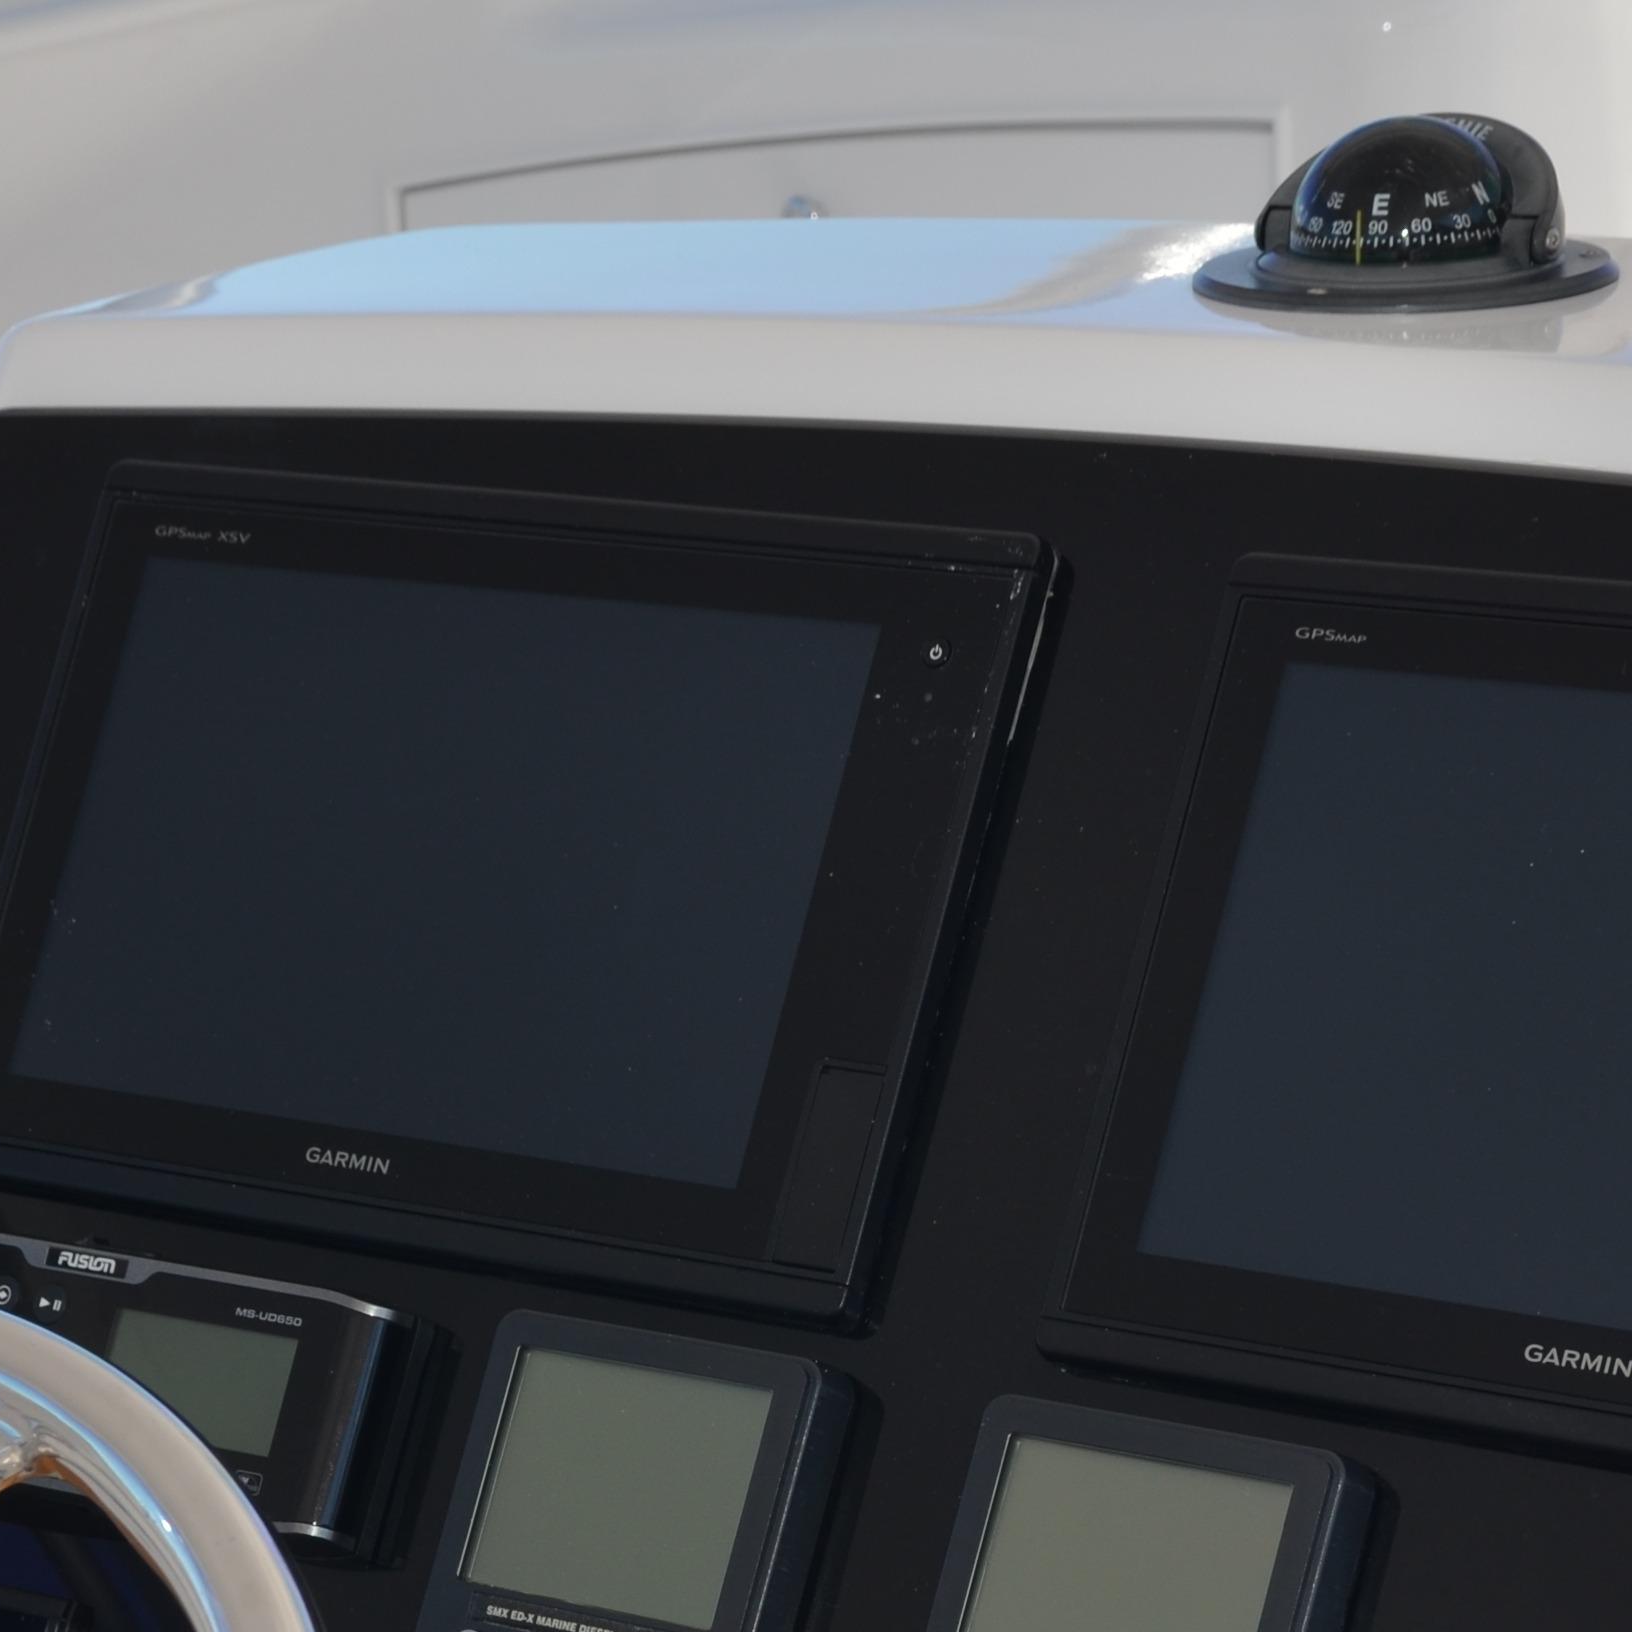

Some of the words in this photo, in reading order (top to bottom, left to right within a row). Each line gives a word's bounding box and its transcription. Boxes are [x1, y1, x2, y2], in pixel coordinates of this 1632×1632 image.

[1326, 191, 1346, 210] SE
[1371, 193, 1391, 217] E
[1424, 190, 1451, 208] NE
[1471, 180, 1491, 206] N
[1331, 219, 1353, 236] 120
[1368, 220, 1389, 236] 90
[1410, 217, 1433, 233] 60
[1452, 213, 1472, 230] 30
[1294, 626, 1368, 644] GPSMAP
[305, 1146, 390, 1175] GARMIN
[57, 1250, 116, 1275] FUSION
[234, 1306, 303, 1327] MS-UD650
[486, 1605, 509, 1619] SMX
[536, 1615, 577, 1632] MARINE
